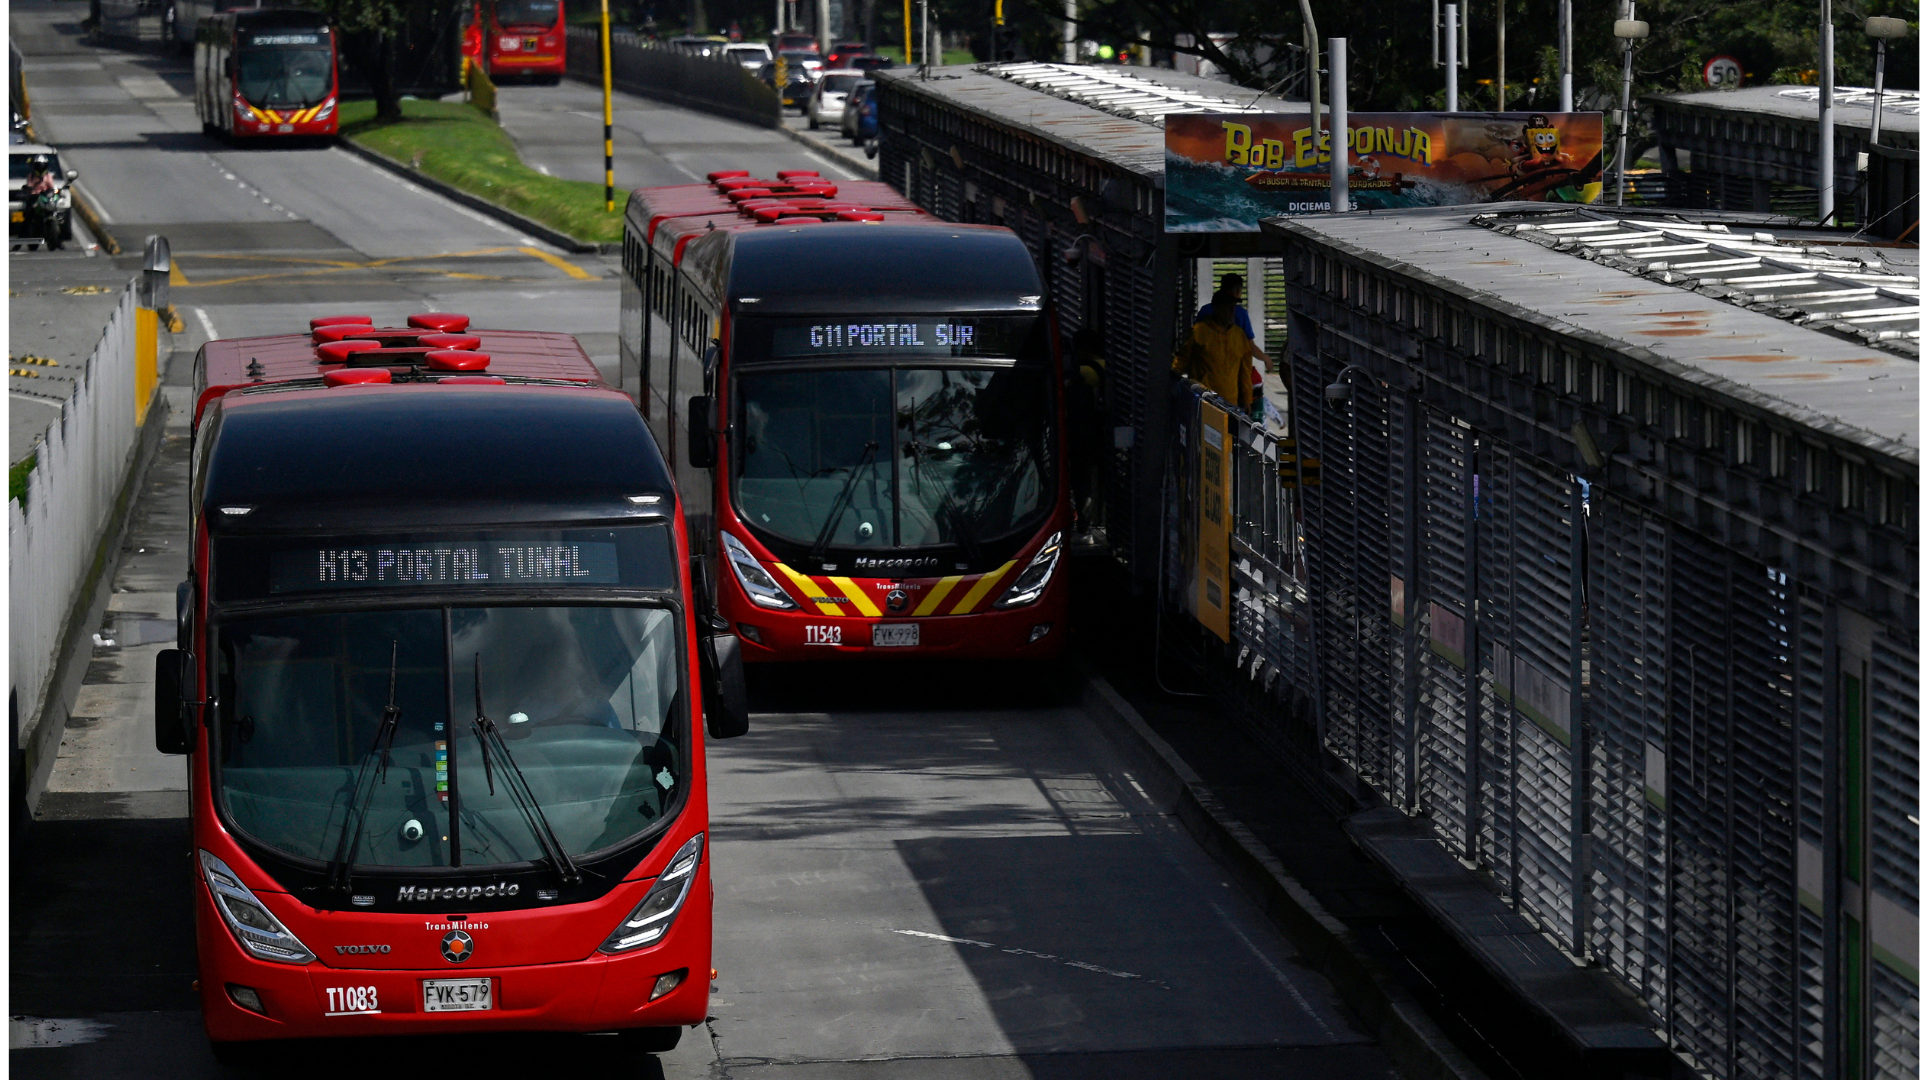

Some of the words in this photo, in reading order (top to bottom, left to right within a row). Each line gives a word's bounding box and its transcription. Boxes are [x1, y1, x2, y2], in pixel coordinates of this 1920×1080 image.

[1713, 66, 1737, 84] 50
[1222, 120, 1284, 171] BOB
[1266, 177, 1290, 186] BUSCA
[1299, 178, 1332, 188] PANTALO
[1348, 180, 1393, 189] CUADRADOS
[1289, 202, 1331, 211] DICIEMB
[810, 325, 842, 347] G11
[848, 324, 925, 346] PORTAL
[935, 324, 973, 346] SUR
[318, 549, 368, 582] H13
[378, 548, 489, 581] PORTAL
[498, 546, 590, 579] TUNAL
[854, 557, 939, 568] Marcopolo
[876, 582, 921, 591] TransMilenio
[810, 596, 850, 604] VOLVO
[805, 625, 842, 643] T1543
[396, 881, 520, 902] Marcopolo
[425, 920, 490, 931] TransMilenio
[334, 944, 392, 955] VOLVO
[326, 986, 378, 1012] T1083
